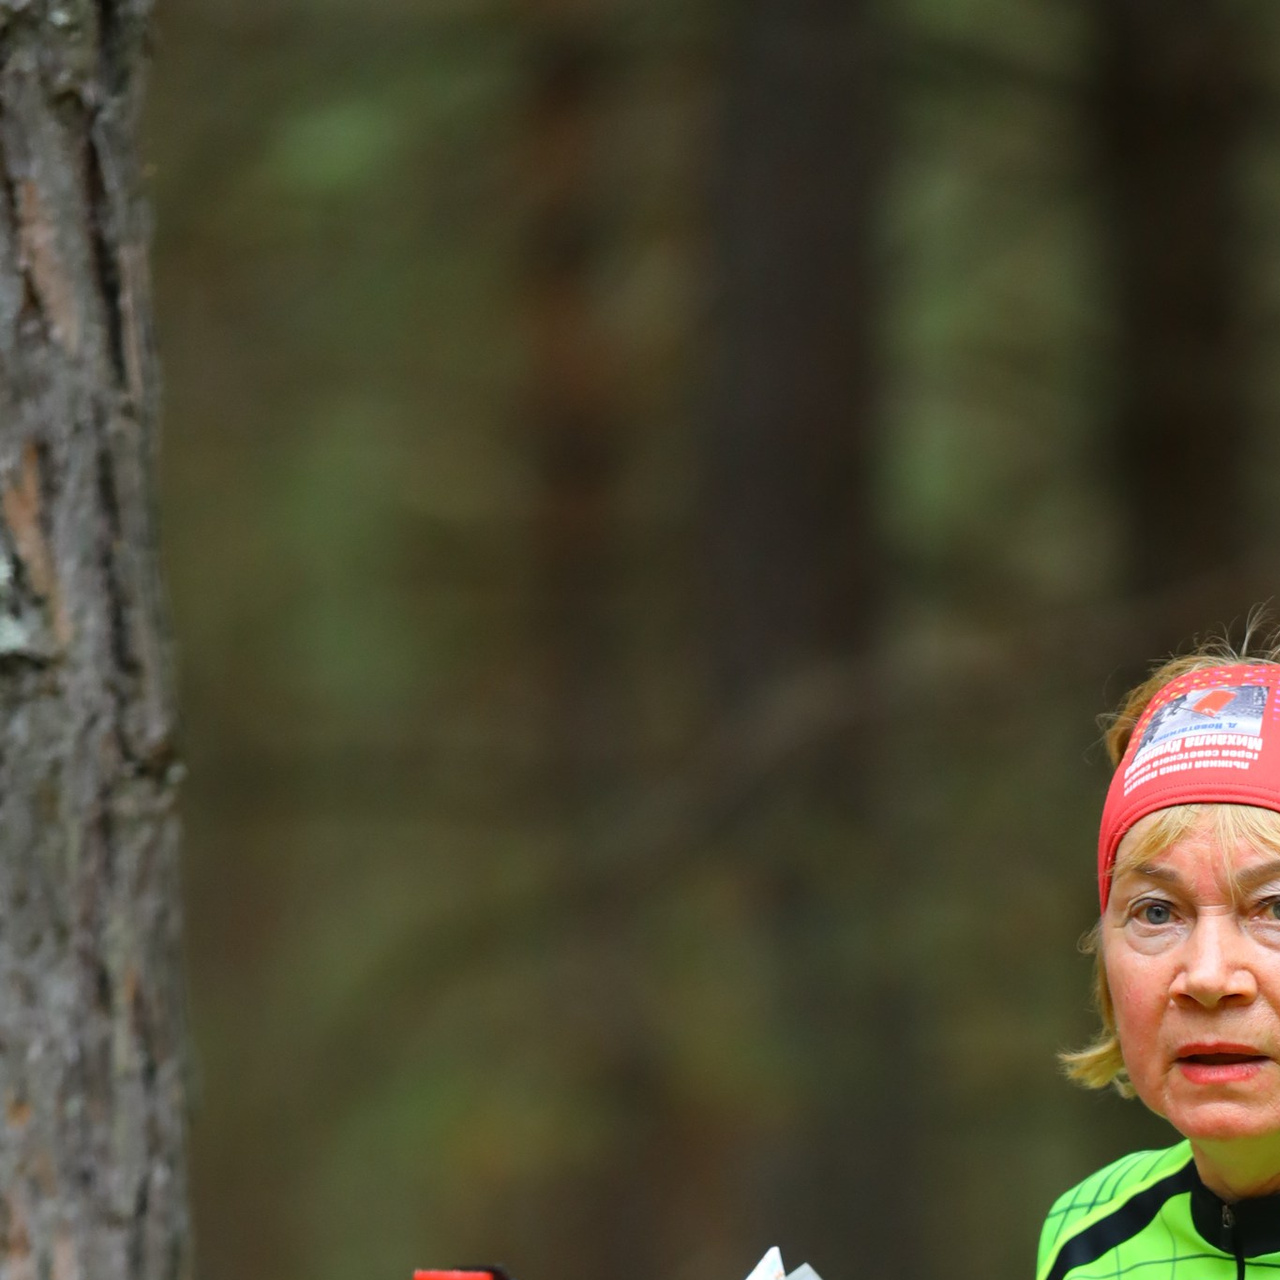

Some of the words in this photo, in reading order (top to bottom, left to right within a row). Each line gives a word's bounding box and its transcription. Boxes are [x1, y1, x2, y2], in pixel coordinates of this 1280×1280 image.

[1184, 734, 1263, 751] Михаила
[1152, 750, 1220, 768] советского
[1160, 762, 1192, 776] гонка
